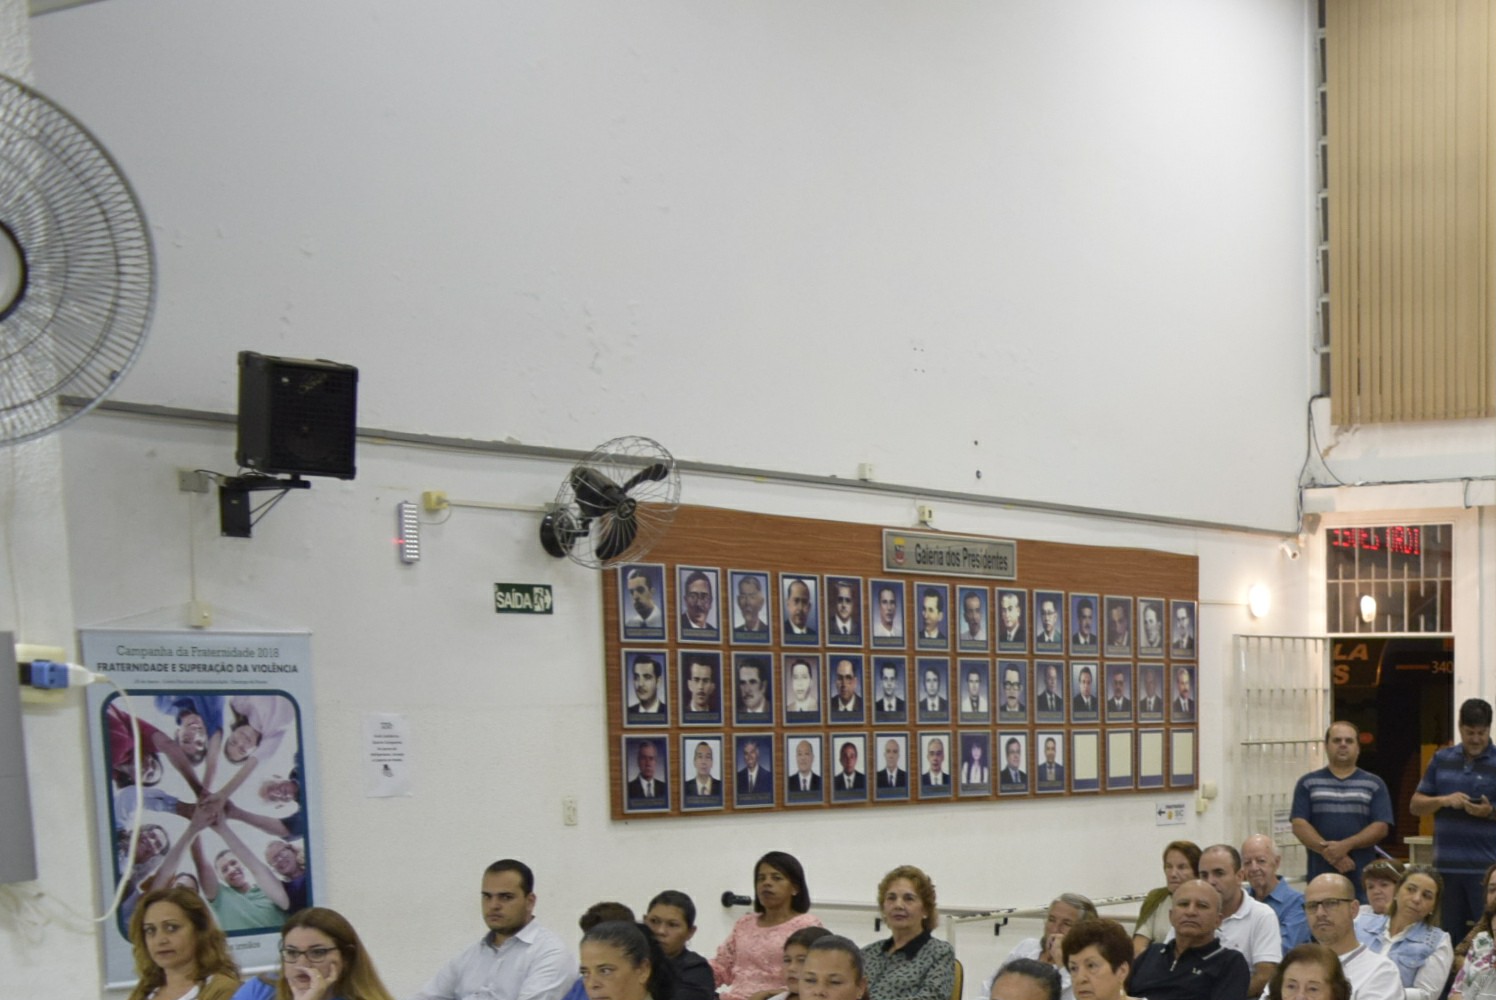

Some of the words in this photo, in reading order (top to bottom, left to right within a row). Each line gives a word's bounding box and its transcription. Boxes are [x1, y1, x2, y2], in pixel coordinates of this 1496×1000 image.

[914, 543, 944, 566] Galeria
[945, 545, 961, 567] dos
[962, 547, 1009, 571] Presidentes
[496, 588, 533, 609] SAÍDA
[116, 645, 174, 659] Campanha
[176, 646, 189, 657] da
[191, 646, 256, 658] Fraternidade
[257, 647, 280, 658] 2018
[97, 662, 169, 672] FRATERNIDADE
[171, 663, 177, 672] E
[179, 661, 234, 675] SUPERAÇÃO
[236, 663, 249, 672] DA
[251, 661, 298, 673] VIOLÊNCIA
